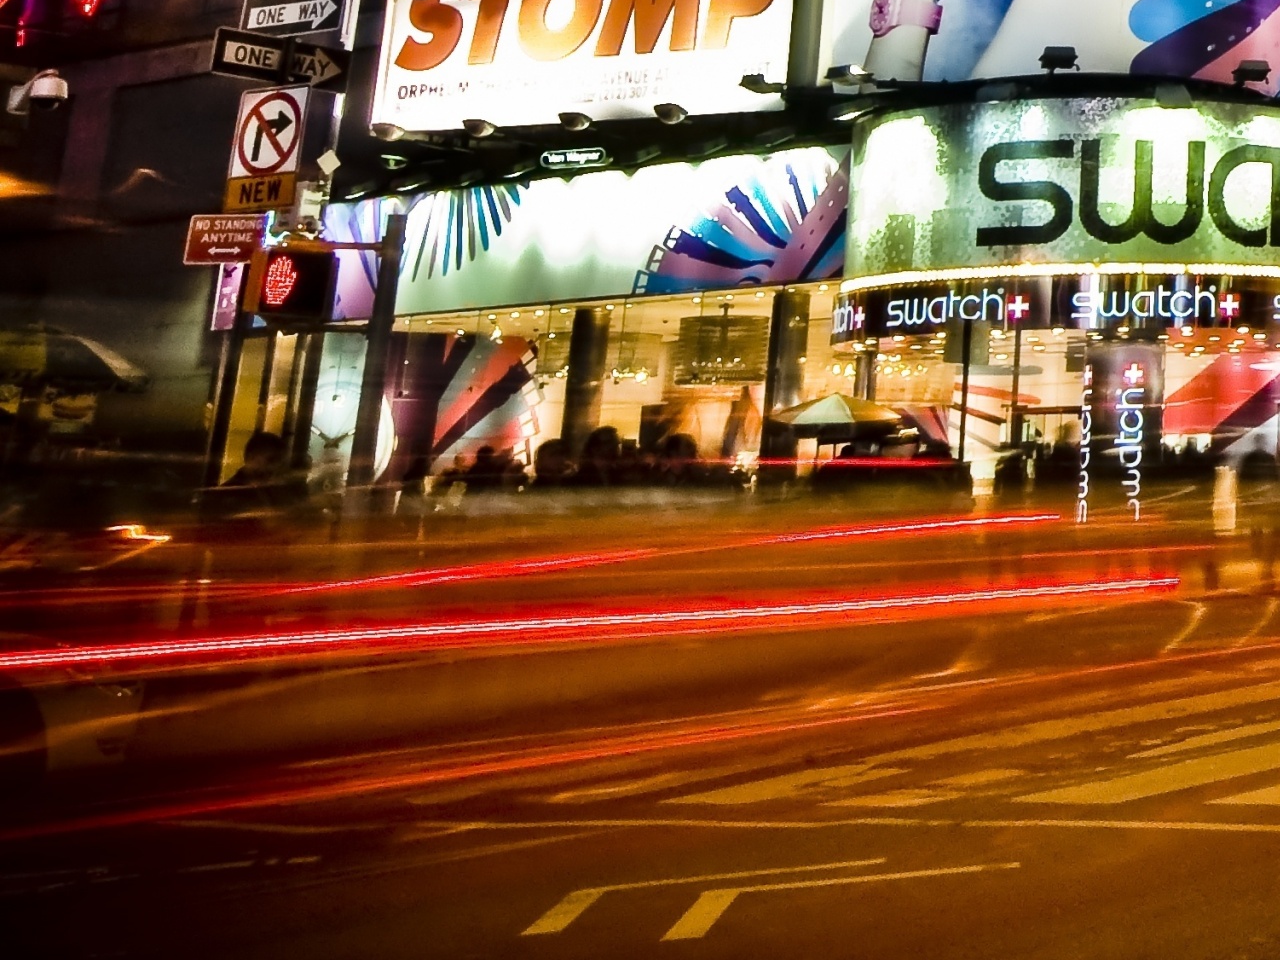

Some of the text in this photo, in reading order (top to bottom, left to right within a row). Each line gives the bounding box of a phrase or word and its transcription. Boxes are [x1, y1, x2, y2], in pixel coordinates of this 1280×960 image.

[256, 1, 330, 25] ONE WAY
[234, 45, 275, 68] ONE
[239, 179, 283, 205] NEW
[195, 219, 263, 231] NO STANDING
[201, 232, 254, 244] ANYTIME
[886, 287, 1004, 328] swatch
[1071, 284, 1217, 319] swatch
